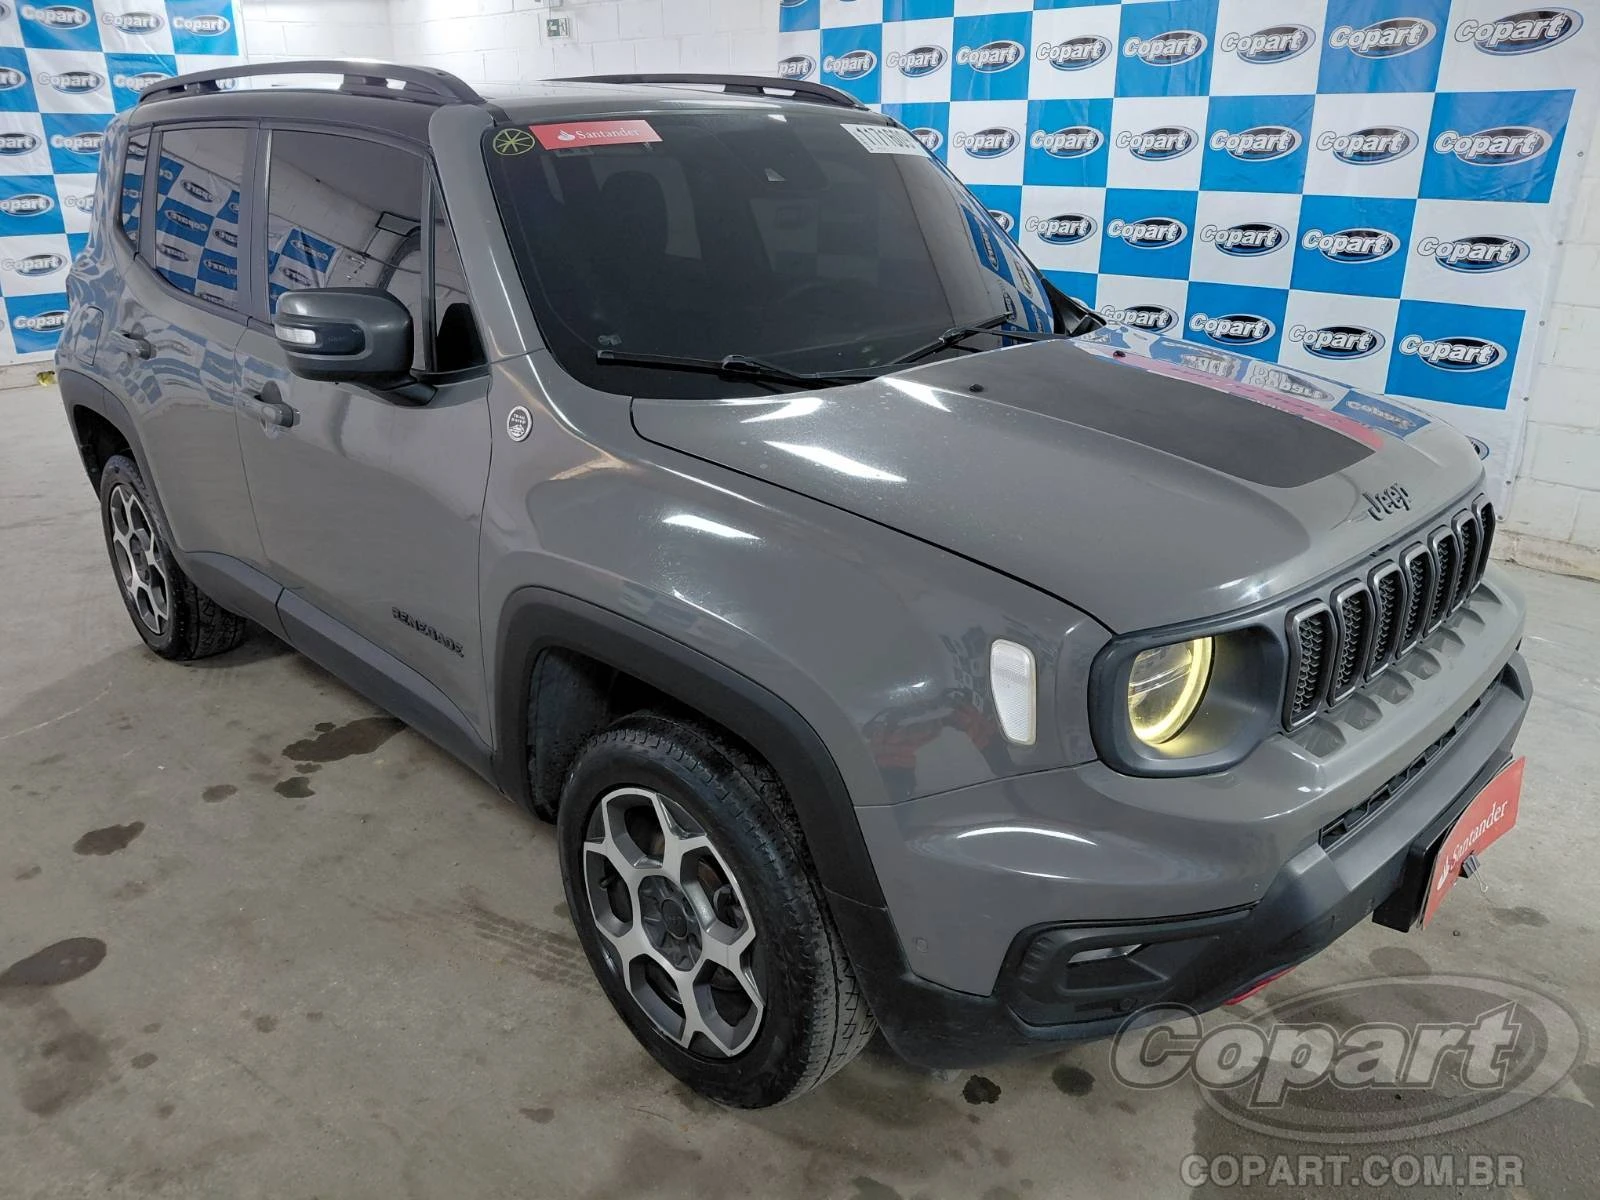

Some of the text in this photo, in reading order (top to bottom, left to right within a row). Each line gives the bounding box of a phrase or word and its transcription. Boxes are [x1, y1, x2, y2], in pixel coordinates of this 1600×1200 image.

[21, 5, 84, 24] Copart
[102, 12, 158, 29] Copart
[173, 16, 224, 31] Copart
[1329, 21, 1425, 52] Copart
[1455, 12, 1567, 44] Copart
[1036, 38, 1104, 62] Copart
[1123, 34, 1199, 60] Copart
[1221, 28, 1306, 54] Copart
[823, 53, 871, 72] Copart
[886, 51, 939, 70] Copart
[956, 45, 1017, 66] Copart
[37, 72, 99, 89] Copart
[51, 134, 104, 150] Copar
[575, 127, 640, 139] Santander
[953, 130, 1011, 151] Copart
[1030, 130, 1097, 152] Copart
[1116, 130, 1188, 154] Copart
[1210, 129, 1292, 156] Copart
[1316, 130, 1405, 160] Copart
[1435, 130, 1542, 160] Copart
[1025, 215, 1091, 236] Copart
[1107, 219, 1178, 242] Copart
[1200, 224, 1278, 249] Copart
[1302, 229, 1389, 256] Copart
[1417, 236, 1517, 264] Copart
[2, 255, 62, 272] Copart
[1189, 313, 1265, 338] Copart
[1289, 325, 1374, 353] Copart
[1399, 334, 1496, 366] Copart
[1362, 482, 1409, 521] Jeep
[1450, 800, 1508, 870] Santander
